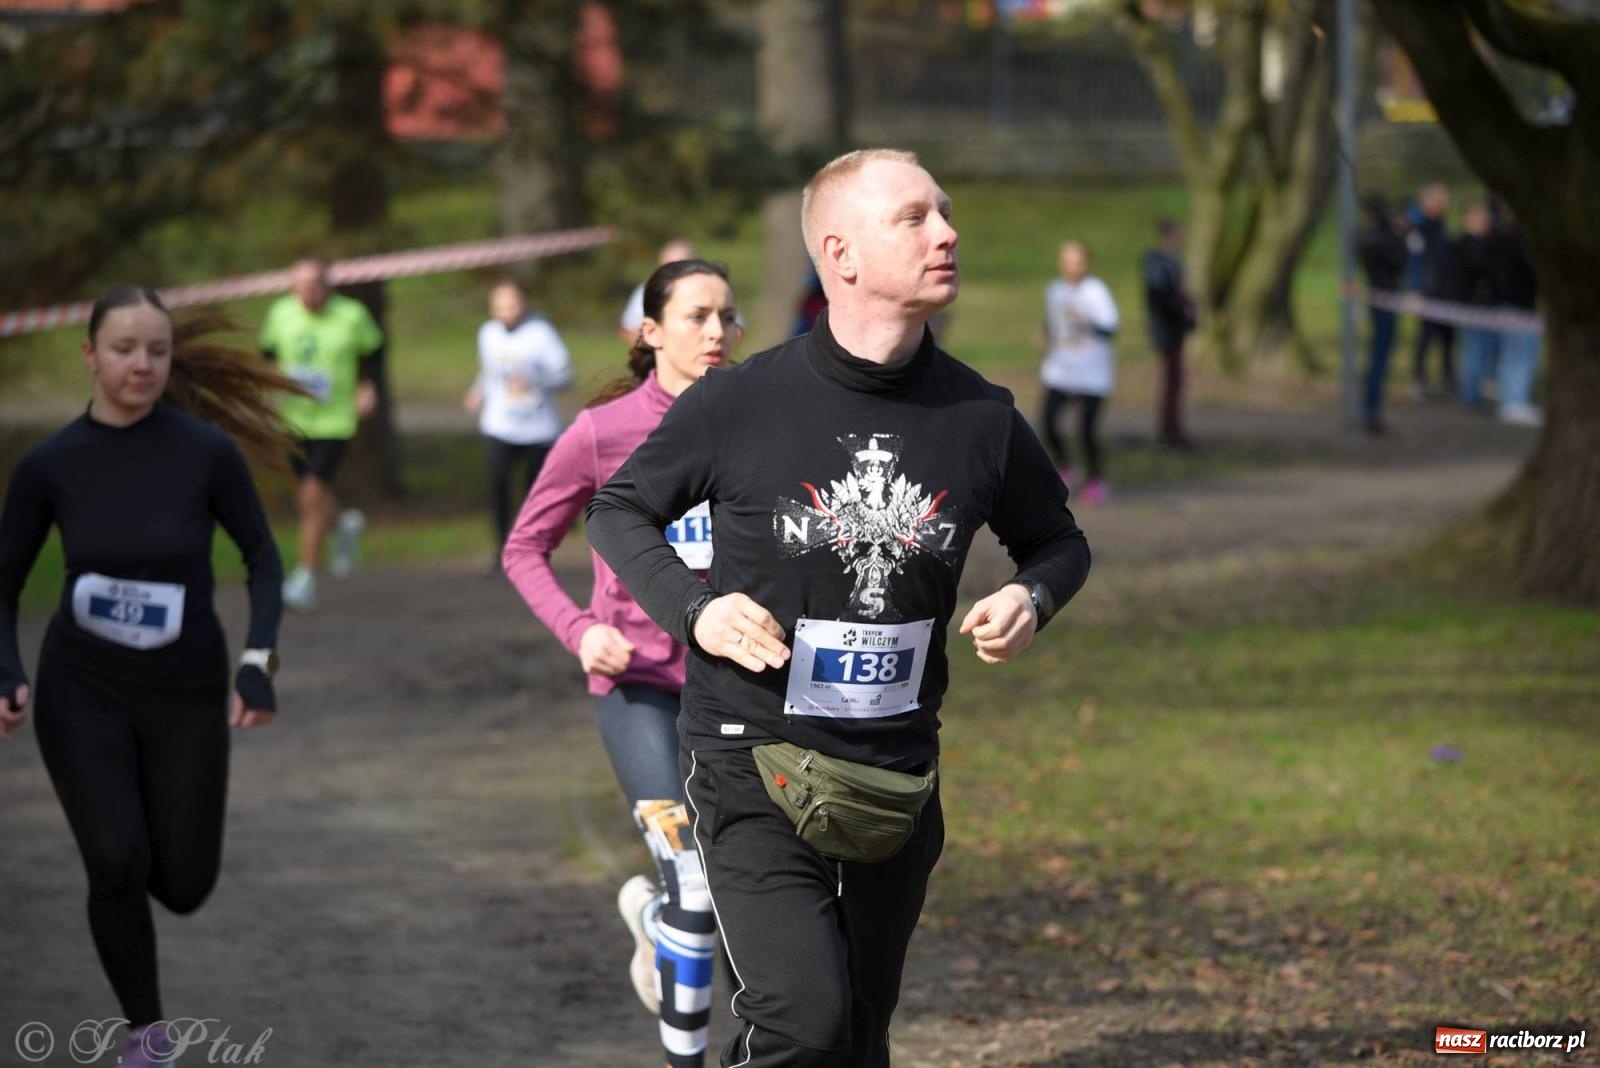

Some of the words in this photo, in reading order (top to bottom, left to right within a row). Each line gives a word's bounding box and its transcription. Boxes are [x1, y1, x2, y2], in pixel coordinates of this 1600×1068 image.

[781, 515, 811, 545] N
[110, 601, 144, 625] 49
[858, 587, 886, 617] S
[861, 637, 899, 647] WILCZYM
[838, 652, 899, 682] 138
